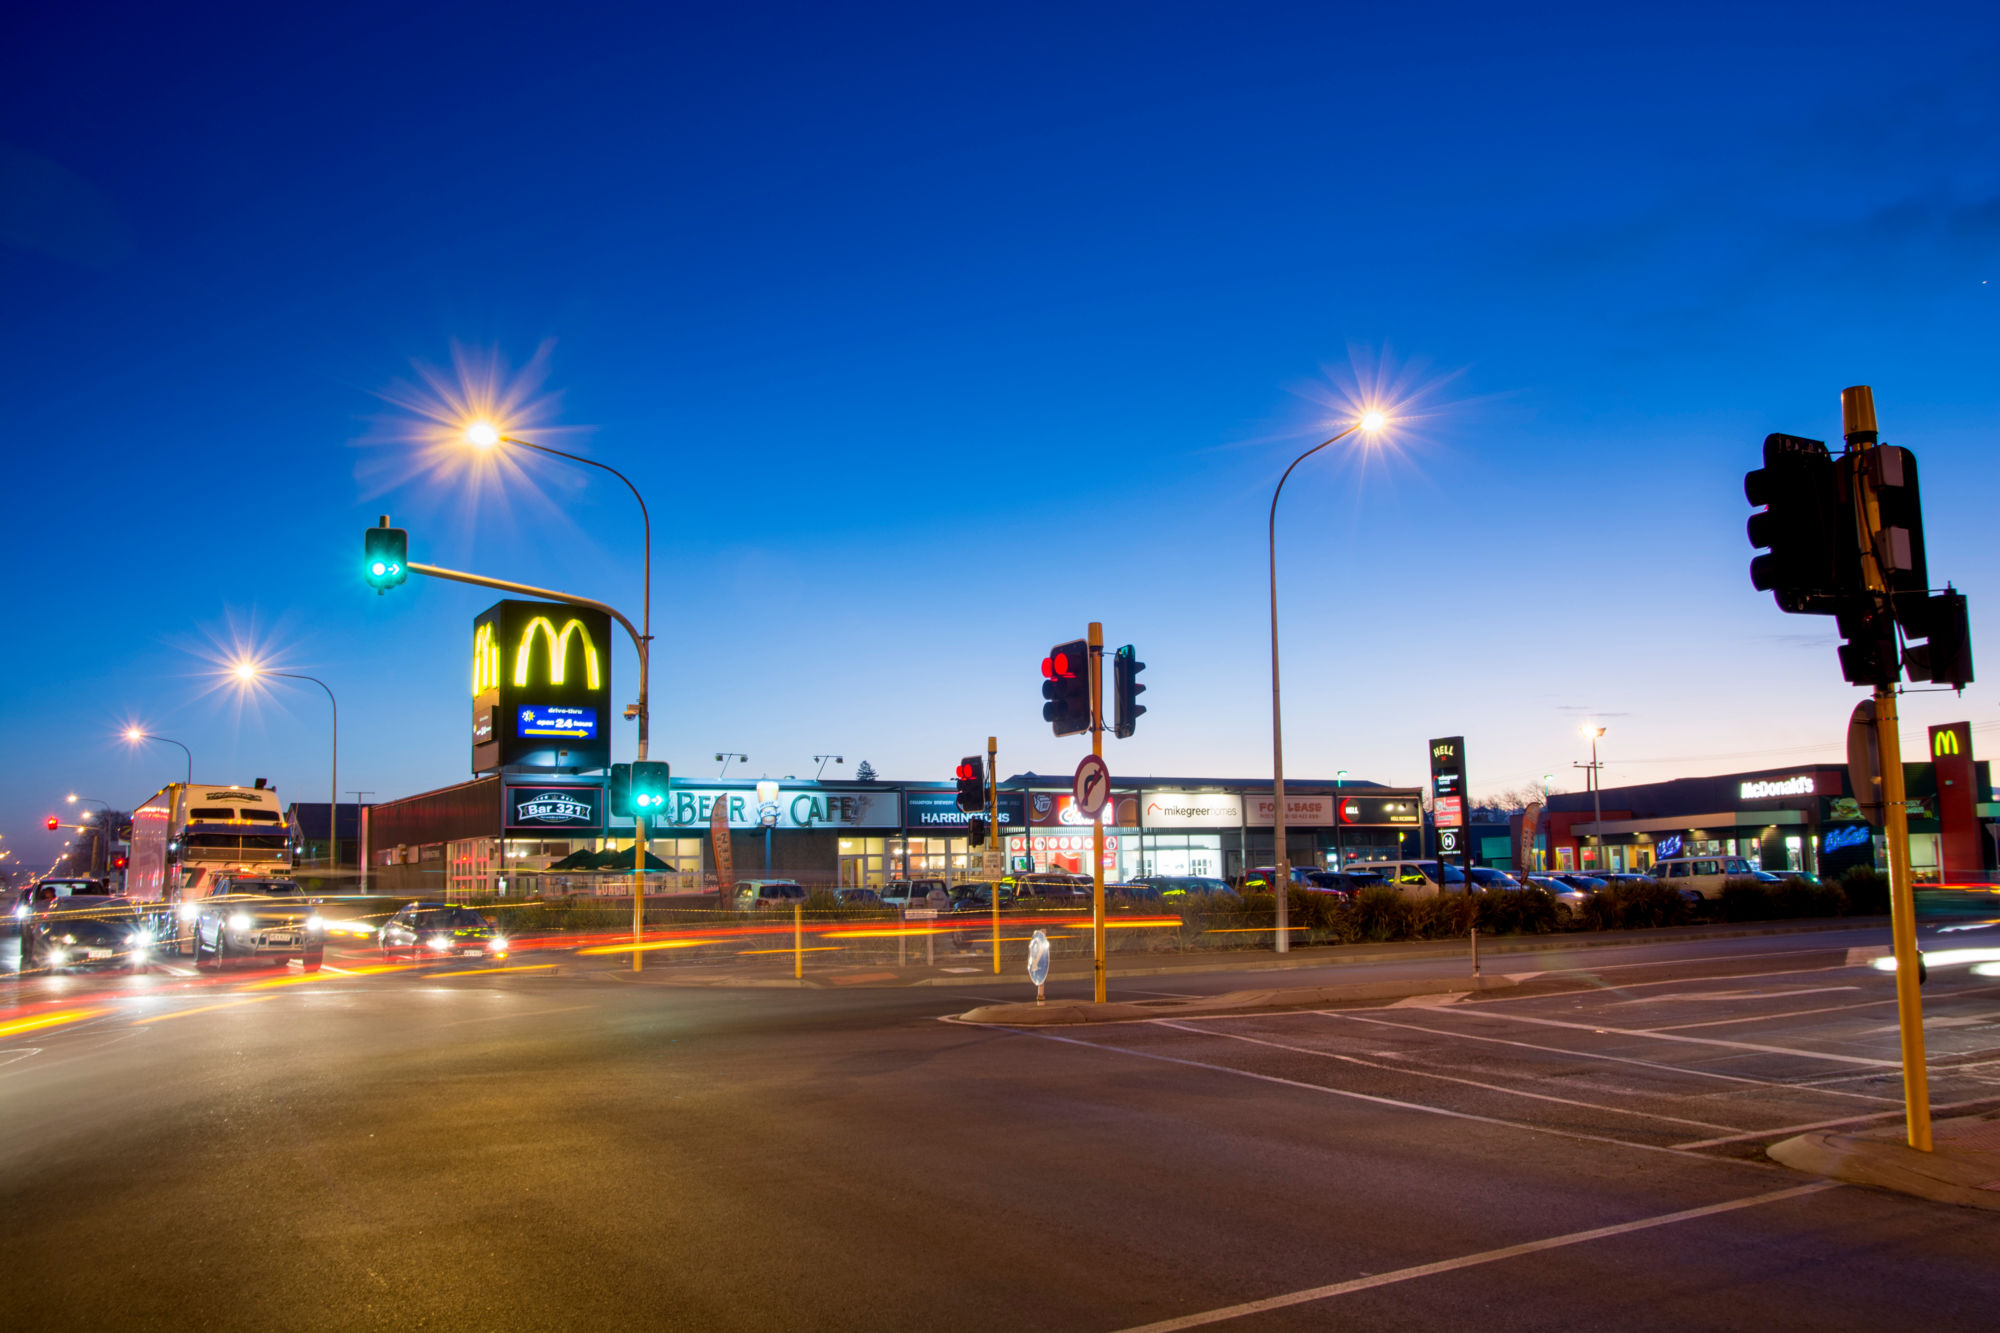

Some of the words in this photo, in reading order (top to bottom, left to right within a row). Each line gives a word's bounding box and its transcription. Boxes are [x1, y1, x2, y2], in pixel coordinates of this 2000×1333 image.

[555, 718, 573, 728] 24
[1433, 744, 1454, 758] HELL
[1741, 776, 1815, 799] McDonald's
[528, 804, 553, 815] Bar
[556, 803, 581, 816] 321
[676, 791, 748, 827] BER
[790, 793, 854, 828] CAFE
[1259, 803, 1275, 812] FO
[1287, 802, 1323, 812] LEASE
